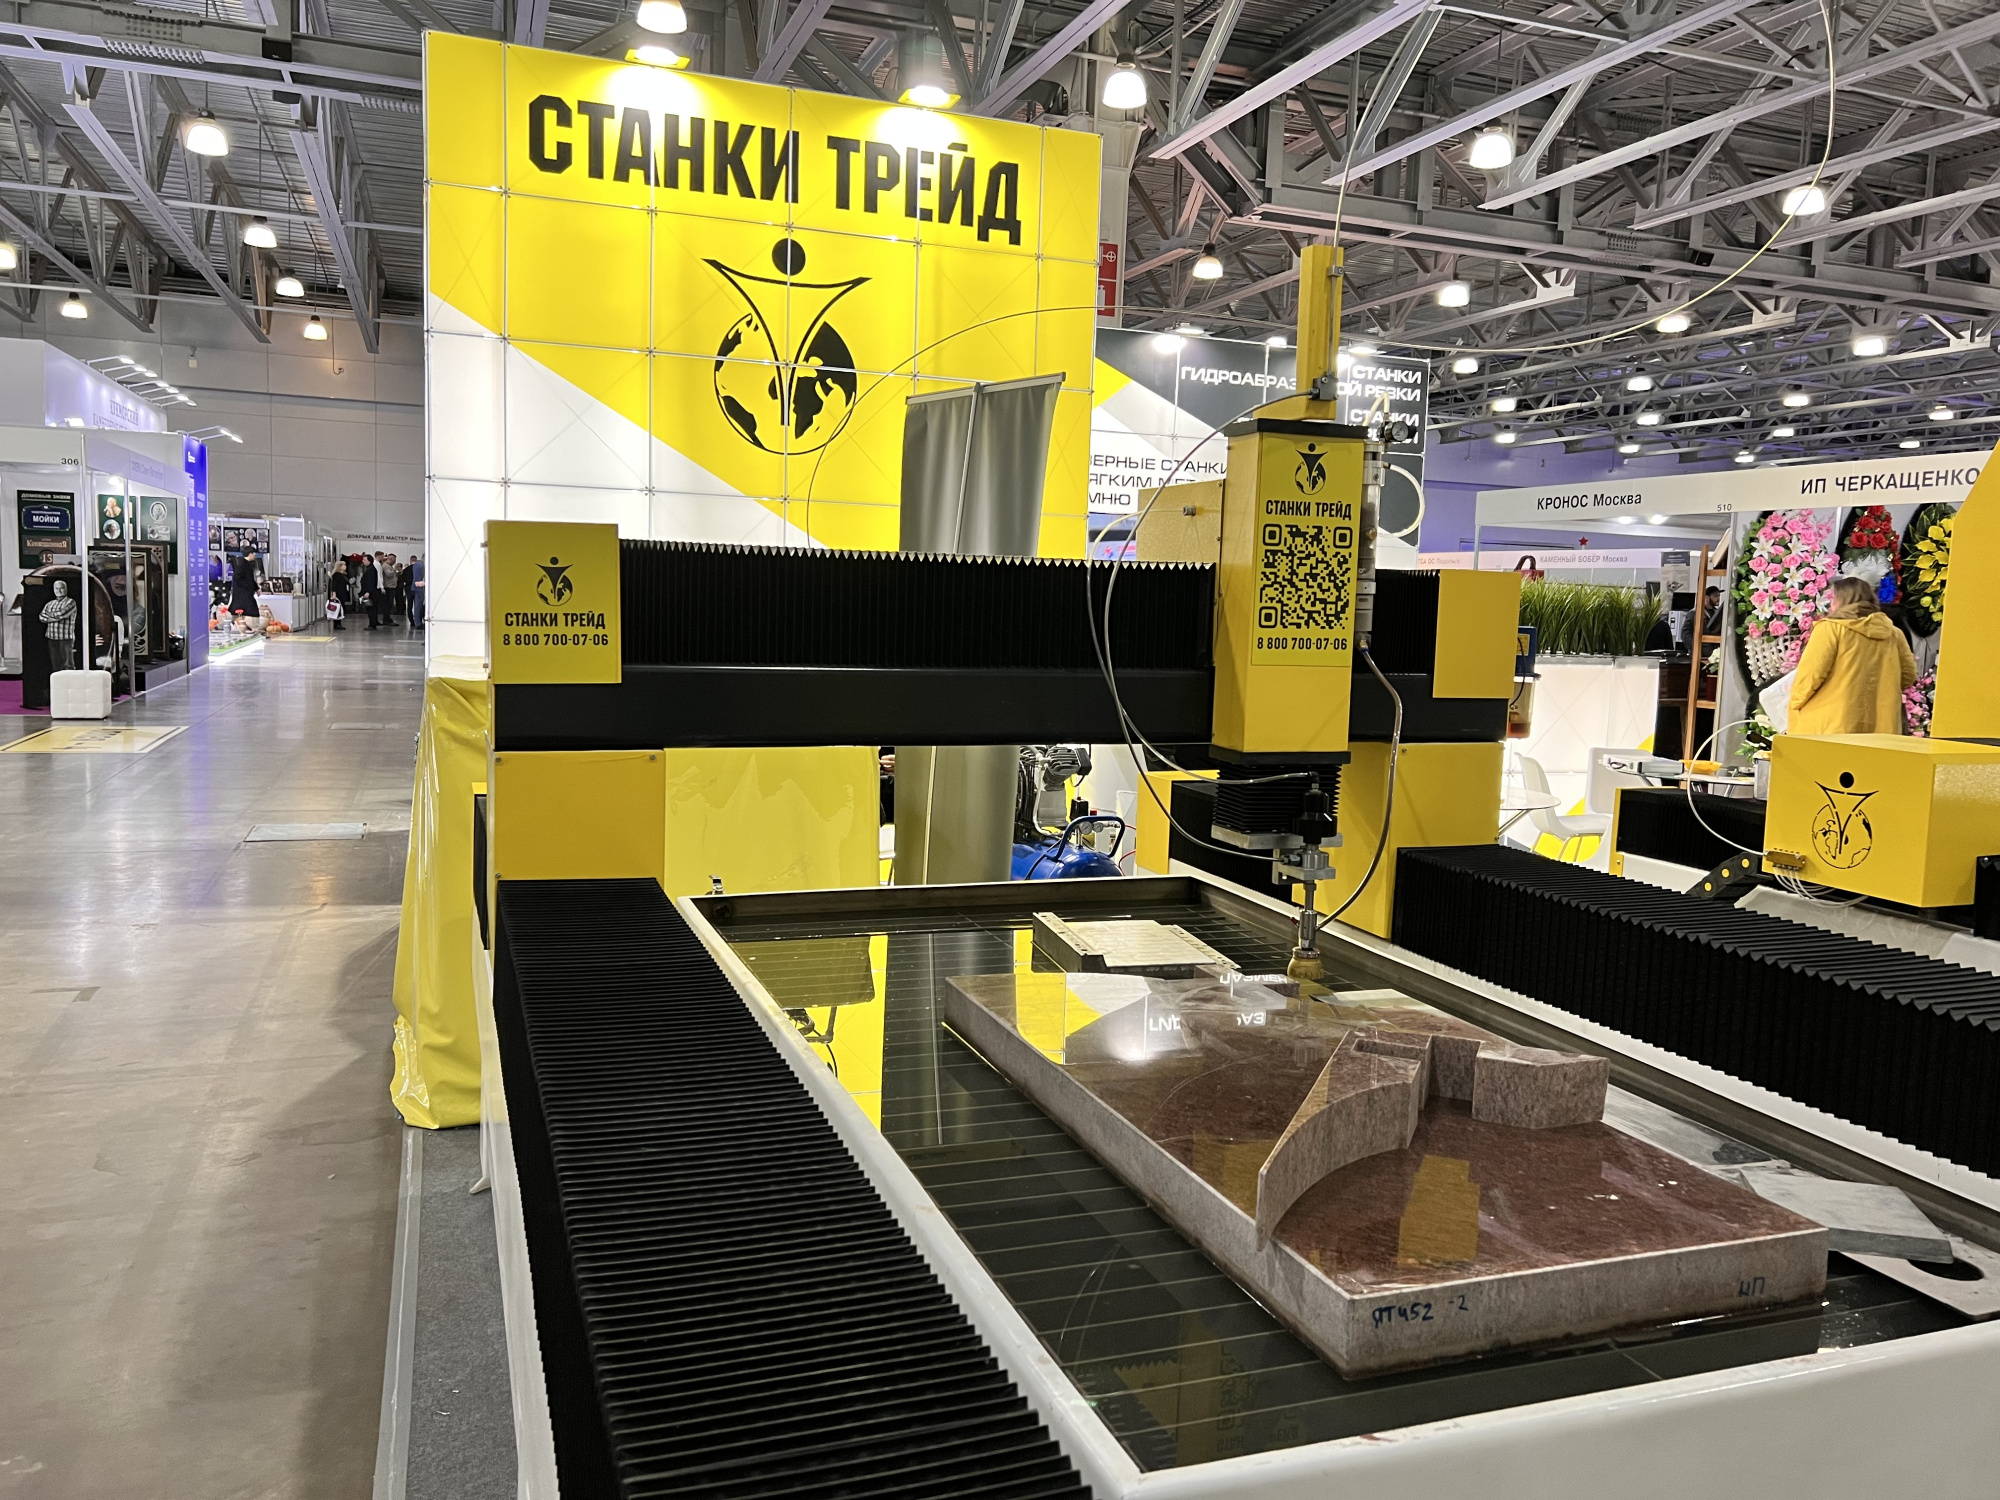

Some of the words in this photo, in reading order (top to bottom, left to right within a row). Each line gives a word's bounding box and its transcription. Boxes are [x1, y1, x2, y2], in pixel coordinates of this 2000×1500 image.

[529, 94, 800, 205] СТАНКИ
[827, 136, 1021, 246] ТРЕЙД
[1352, 364, 1422, 385] СТАНКИ
[1365, 384, 1421, 402] РЕЗКИ
[61, 458, 79, 466] 306
[1090, 454, 1156, 470] ЕРНЫЕ
[1801, 478, 1827, 495] ИП
[1835, 467, 1981, 492] ЧЕРКАЩЕНКО
[1537, 494, 1588, 511] КРОНОС
[1593, 493, 1642, 507] Москва
[1717, 503, 1732, 512] 510
[32, 514, 60, 523] МОЙКИ
[1266, 500, 1311, 517] СТАНКИ
[1315, 501, 1352, 521] ТРЕЙД
[42, 553, 53, 563] 13
[1540, 554, 1576, 563] КАМЕННЫЙ
[1578, 554, 1600, 563] БОБЁР
[1602, 555, 1628, 563] Москва
[505, 612, 558, 627] СТАНКИ
[563, 610, 606, 630] ТРЕЙД
[503, 633, 511, 646] 8
[514, 633, 539, 646] 800
[543, 633, 609, 646] 700-07-06
[1257, 637, 1264, 649] 8
[1267, 637, 1288, 650] 800
[1291, 637, 1348, 650] 700-07-06
